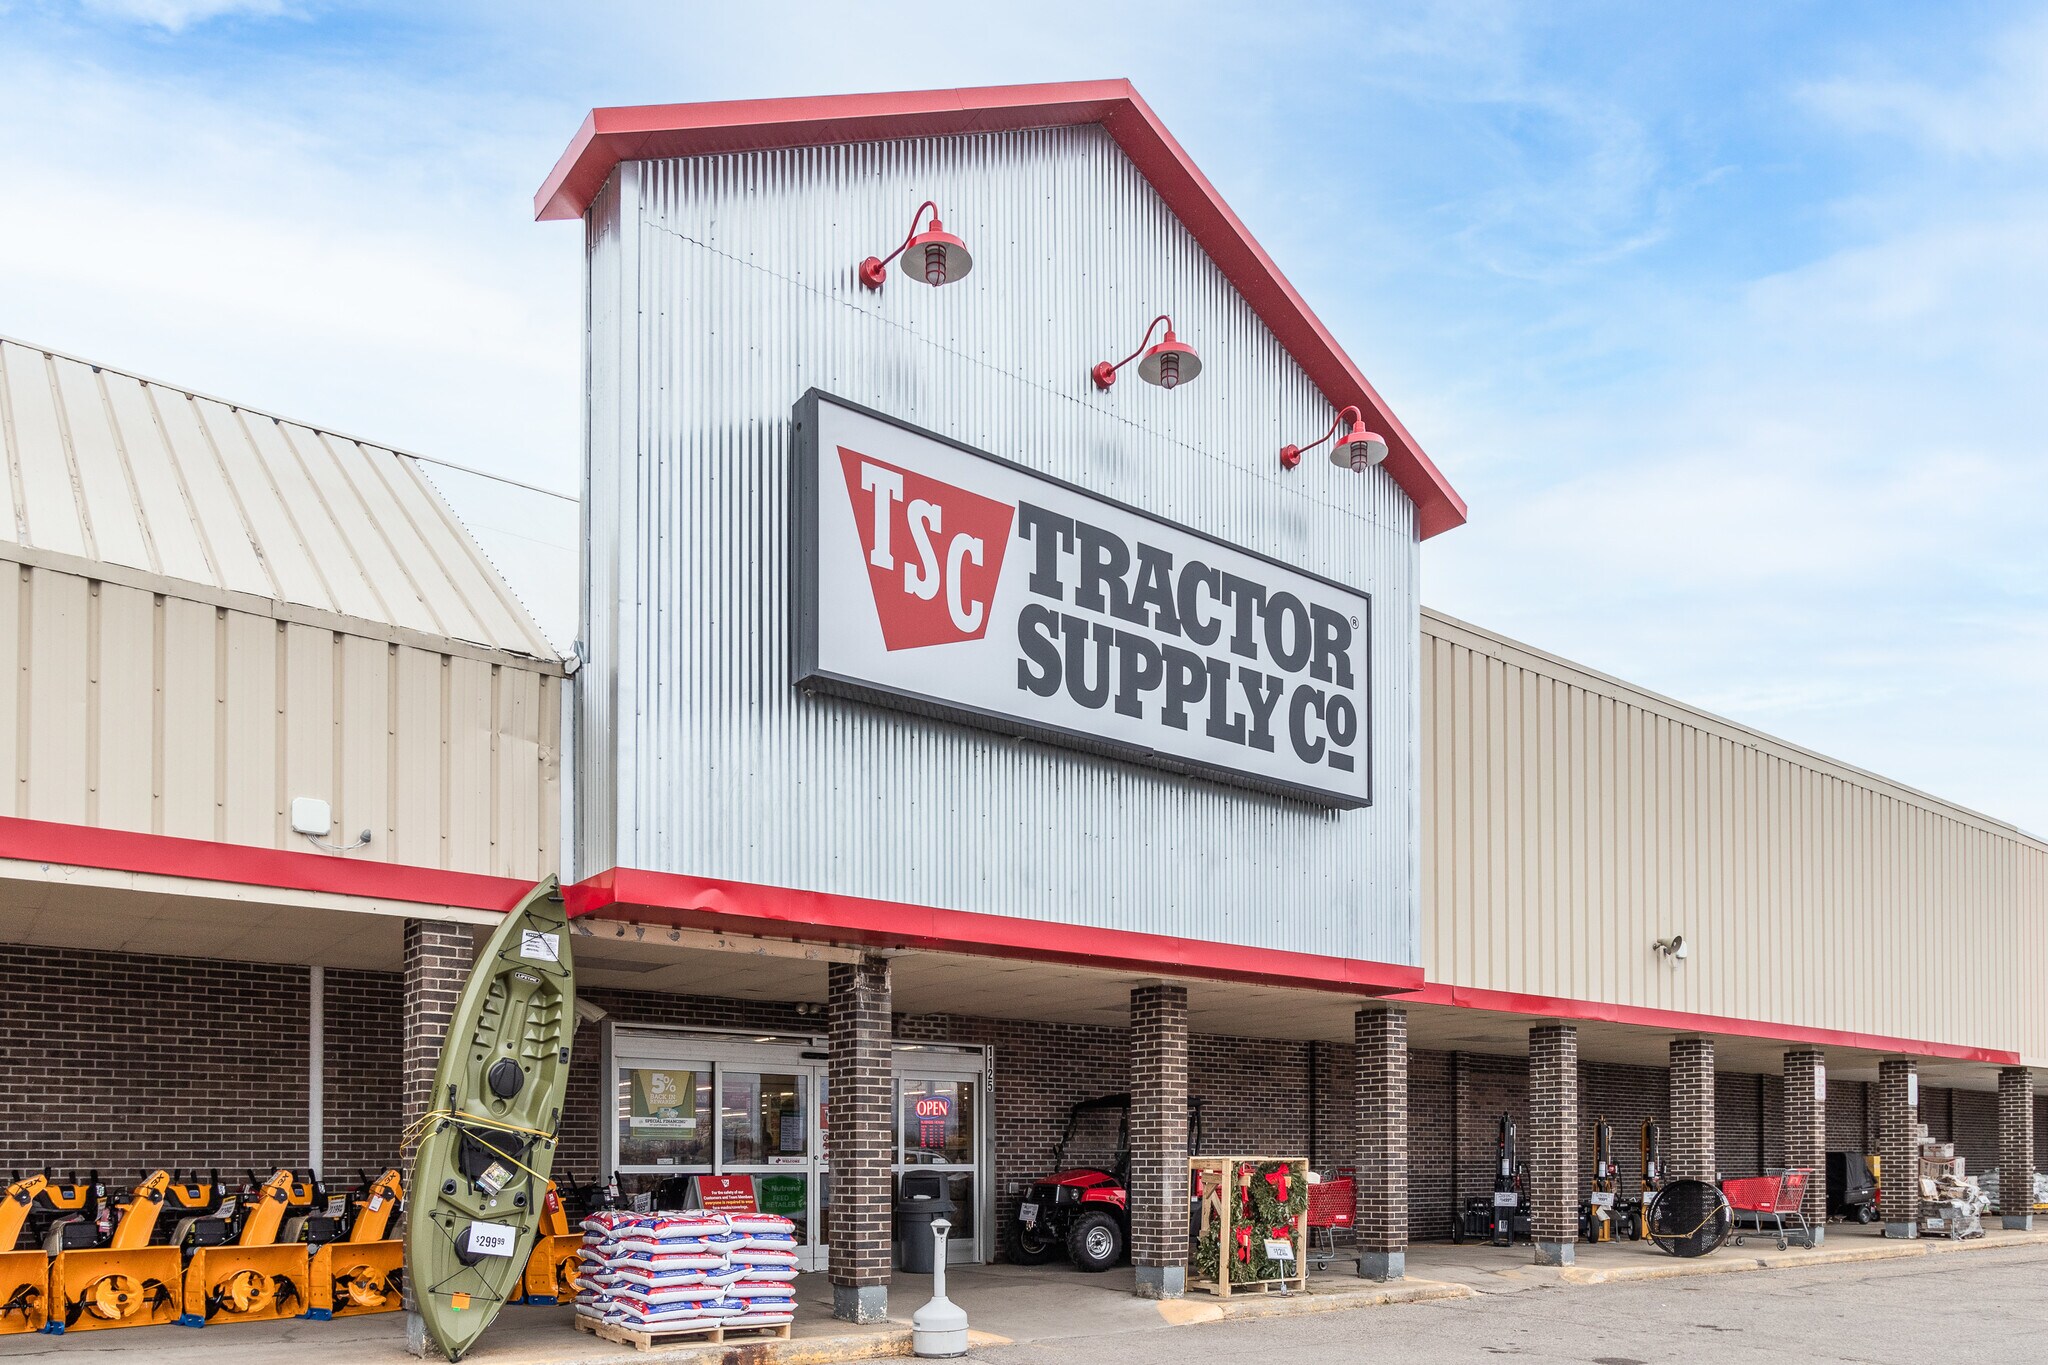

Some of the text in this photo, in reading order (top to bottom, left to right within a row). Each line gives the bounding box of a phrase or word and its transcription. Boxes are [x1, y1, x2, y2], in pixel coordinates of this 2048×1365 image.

[861, 460, 984, 633] TSC
[1016, 603, 1283, 752] SUPPLY
[651, 1073, 677, 1094] 5%
[917, 1100, 948, 1116] OPEN
